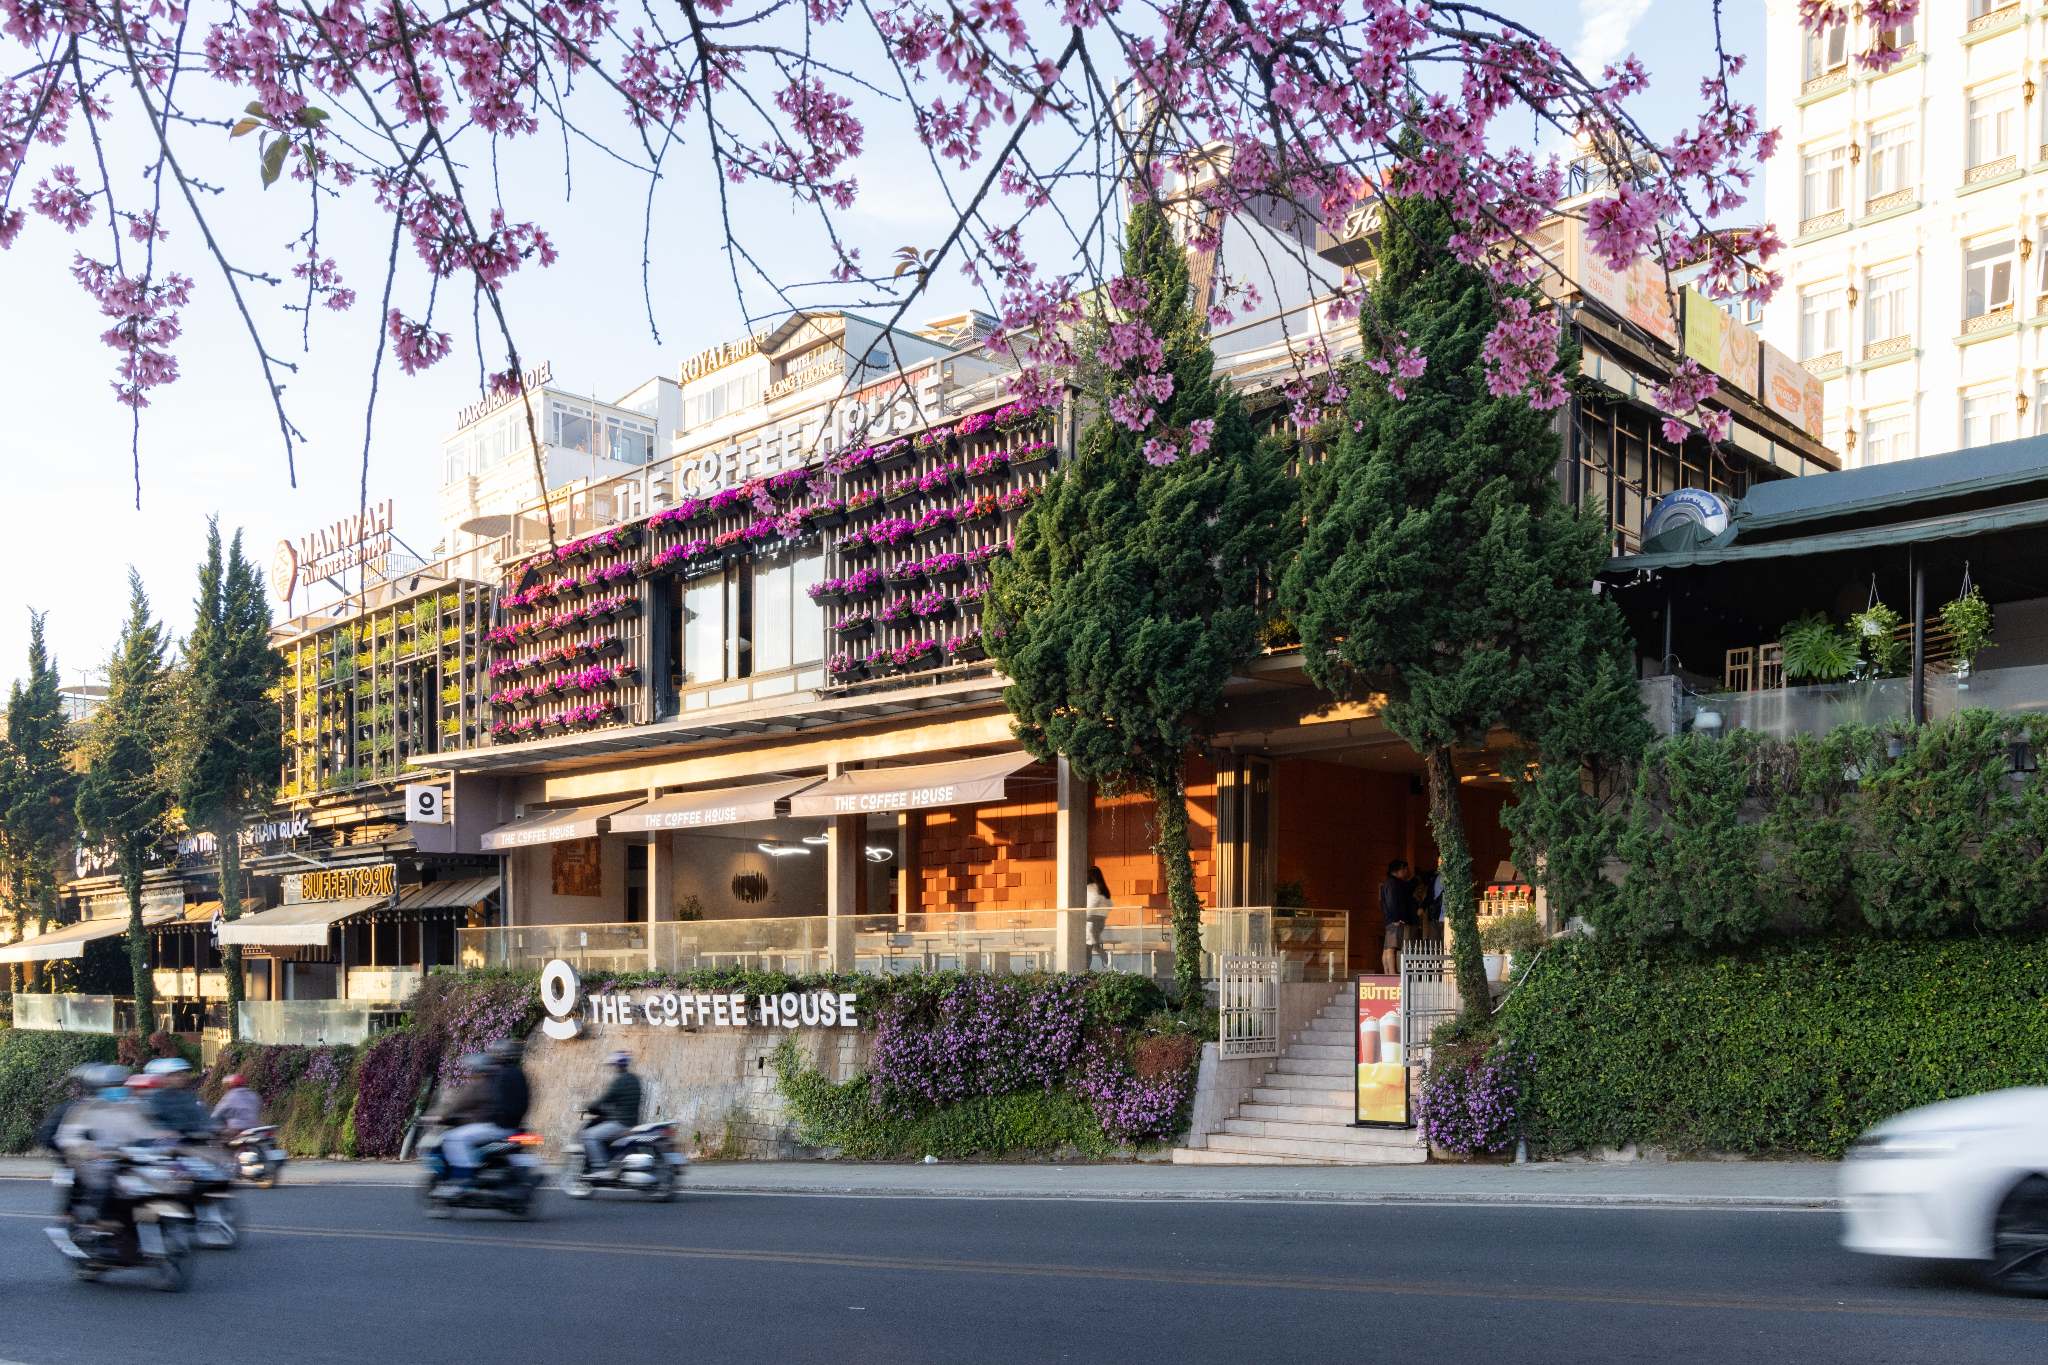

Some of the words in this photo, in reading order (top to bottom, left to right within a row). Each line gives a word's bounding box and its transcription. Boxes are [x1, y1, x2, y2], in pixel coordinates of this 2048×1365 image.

[678, 341, 730, 385] ROYAL
[786, 351, 812, 376] HOTEL
[769, 376, 796, 398] LONG
[613, 470, 668, 523] THE
[678, 421, 803, 499] COFFEE
[804, 374, 944, 456] HOUSE
[299, 498, 393, 567] MANWAH
[833, 796, 856, 811] THE
[860, 792, 907, 810] COFFEE
[912, 786, 954, 806] HOUSE
[279, 812, 309, 839] QUỐC
[645, 813, 662, 827] THE
[665, 810, 701, 826] COFFEE
[704, 807, 737, 822] HOUSE
[501, 833, 515, 845] THE
[518, 829, 547, 844] COFFEE
[549, 825, 575, 841] HOUSE
[302, 867, 355, 900] BUFFET
[355, 864, 394, 897] 199K
[589, 994, 634, 1025] THE
[645, 993, 749, 1029] COFFEE
[760, 992, 858, 1029] HOUSE
